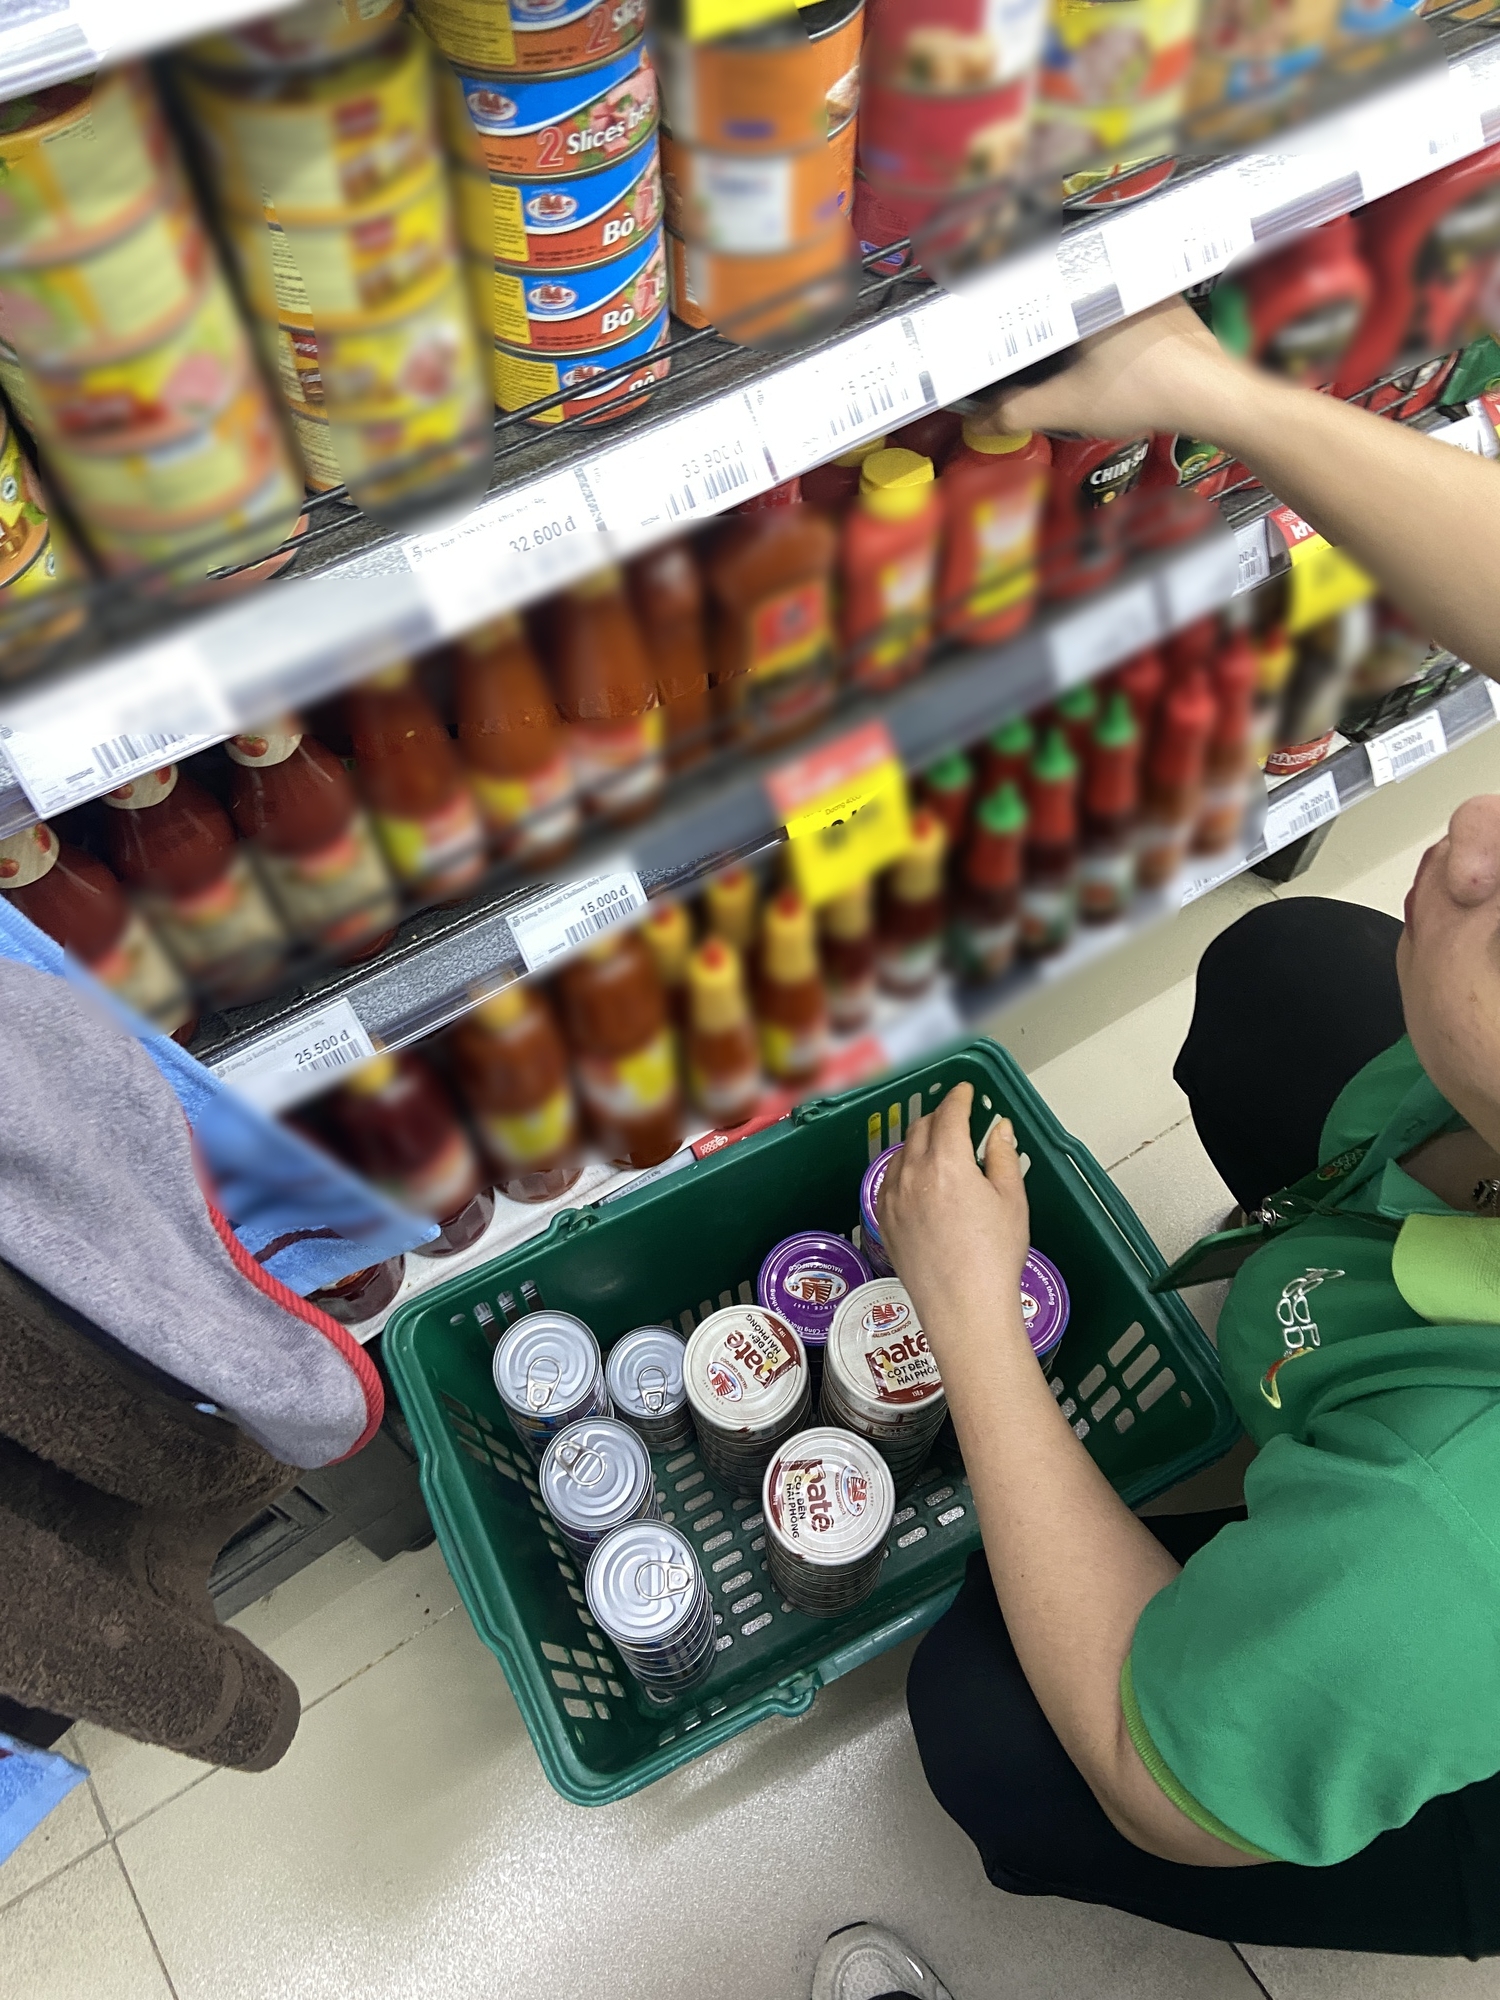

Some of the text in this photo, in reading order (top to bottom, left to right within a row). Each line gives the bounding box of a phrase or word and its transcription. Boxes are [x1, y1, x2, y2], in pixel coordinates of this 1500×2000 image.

[586, 3, 611, 54] 2
[536, 126, 564, 169] 2
[566, 119, 626, 156] Slices
[602, 211, 635, 246] Bò
[601, 303, 634, 334] Bò
[1089, 442, 1149, 486] CHIN-SU
[509, 516, 577, 553] 32.600 đ
[580, 884, 629, 916] 15.000 đ
[294, 1029, 351, 1065] 25.500 đ
